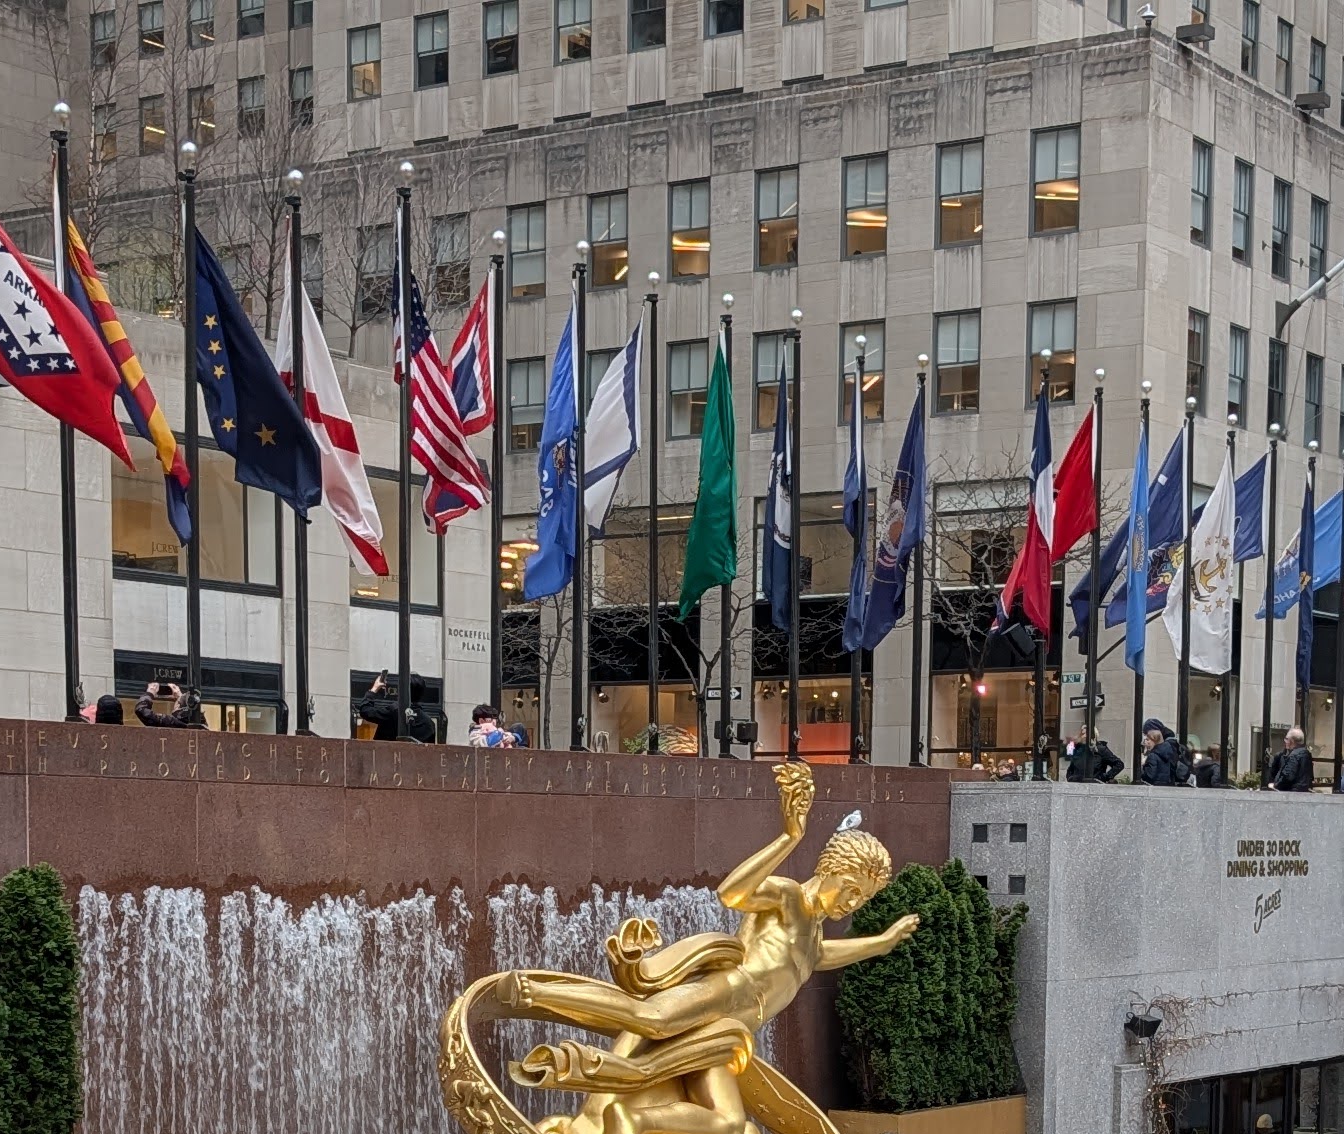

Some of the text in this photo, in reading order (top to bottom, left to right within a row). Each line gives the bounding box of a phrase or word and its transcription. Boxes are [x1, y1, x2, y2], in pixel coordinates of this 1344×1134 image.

[448, 627, 491, 640] ROCKEFELL
[462, 642, 486, 652] PLAZA
[159, 737, 328, 762] TEACHER
[440, 754, 533, 772] EVERY
[565, 760, 611, 776] ART
[100, 760, 251, 781] PROVED
[295, 768, 330, 784] TO
[1237, 840, 1301, 857] UNDER 30 ROCK
[1227, 860, 1308, 877] DINING & SHOPPING
[1254, 893, 1263, 933] 5
